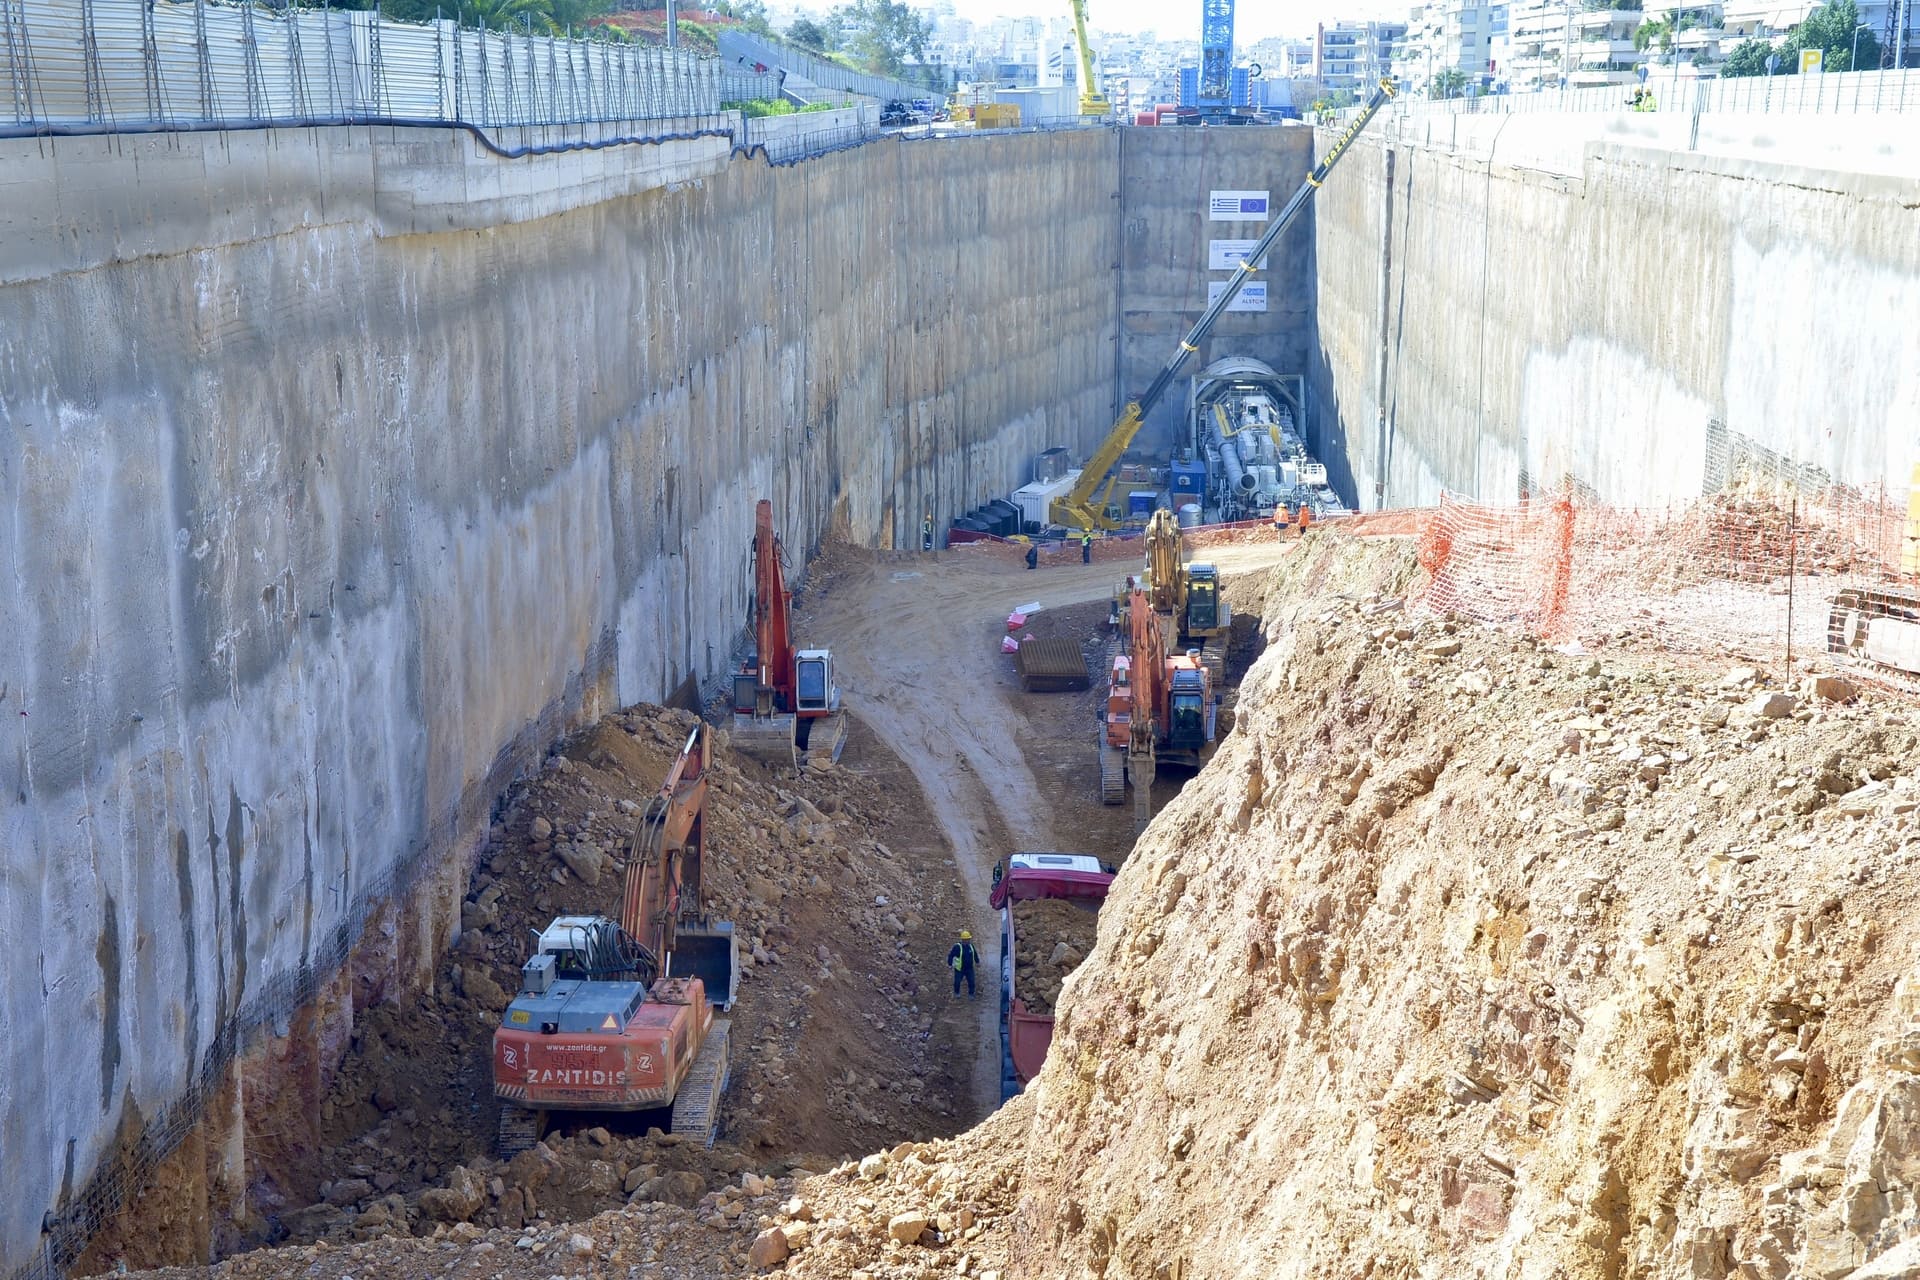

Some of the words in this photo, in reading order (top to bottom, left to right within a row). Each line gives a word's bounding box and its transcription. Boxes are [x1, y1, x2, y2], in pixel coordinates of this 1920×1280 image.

[1803, 51, 1821, 72] P
[546, 1043, 607, 1053] www.zantidis.gr
[527, 1069, 626, 1085] ZANTIDIS
